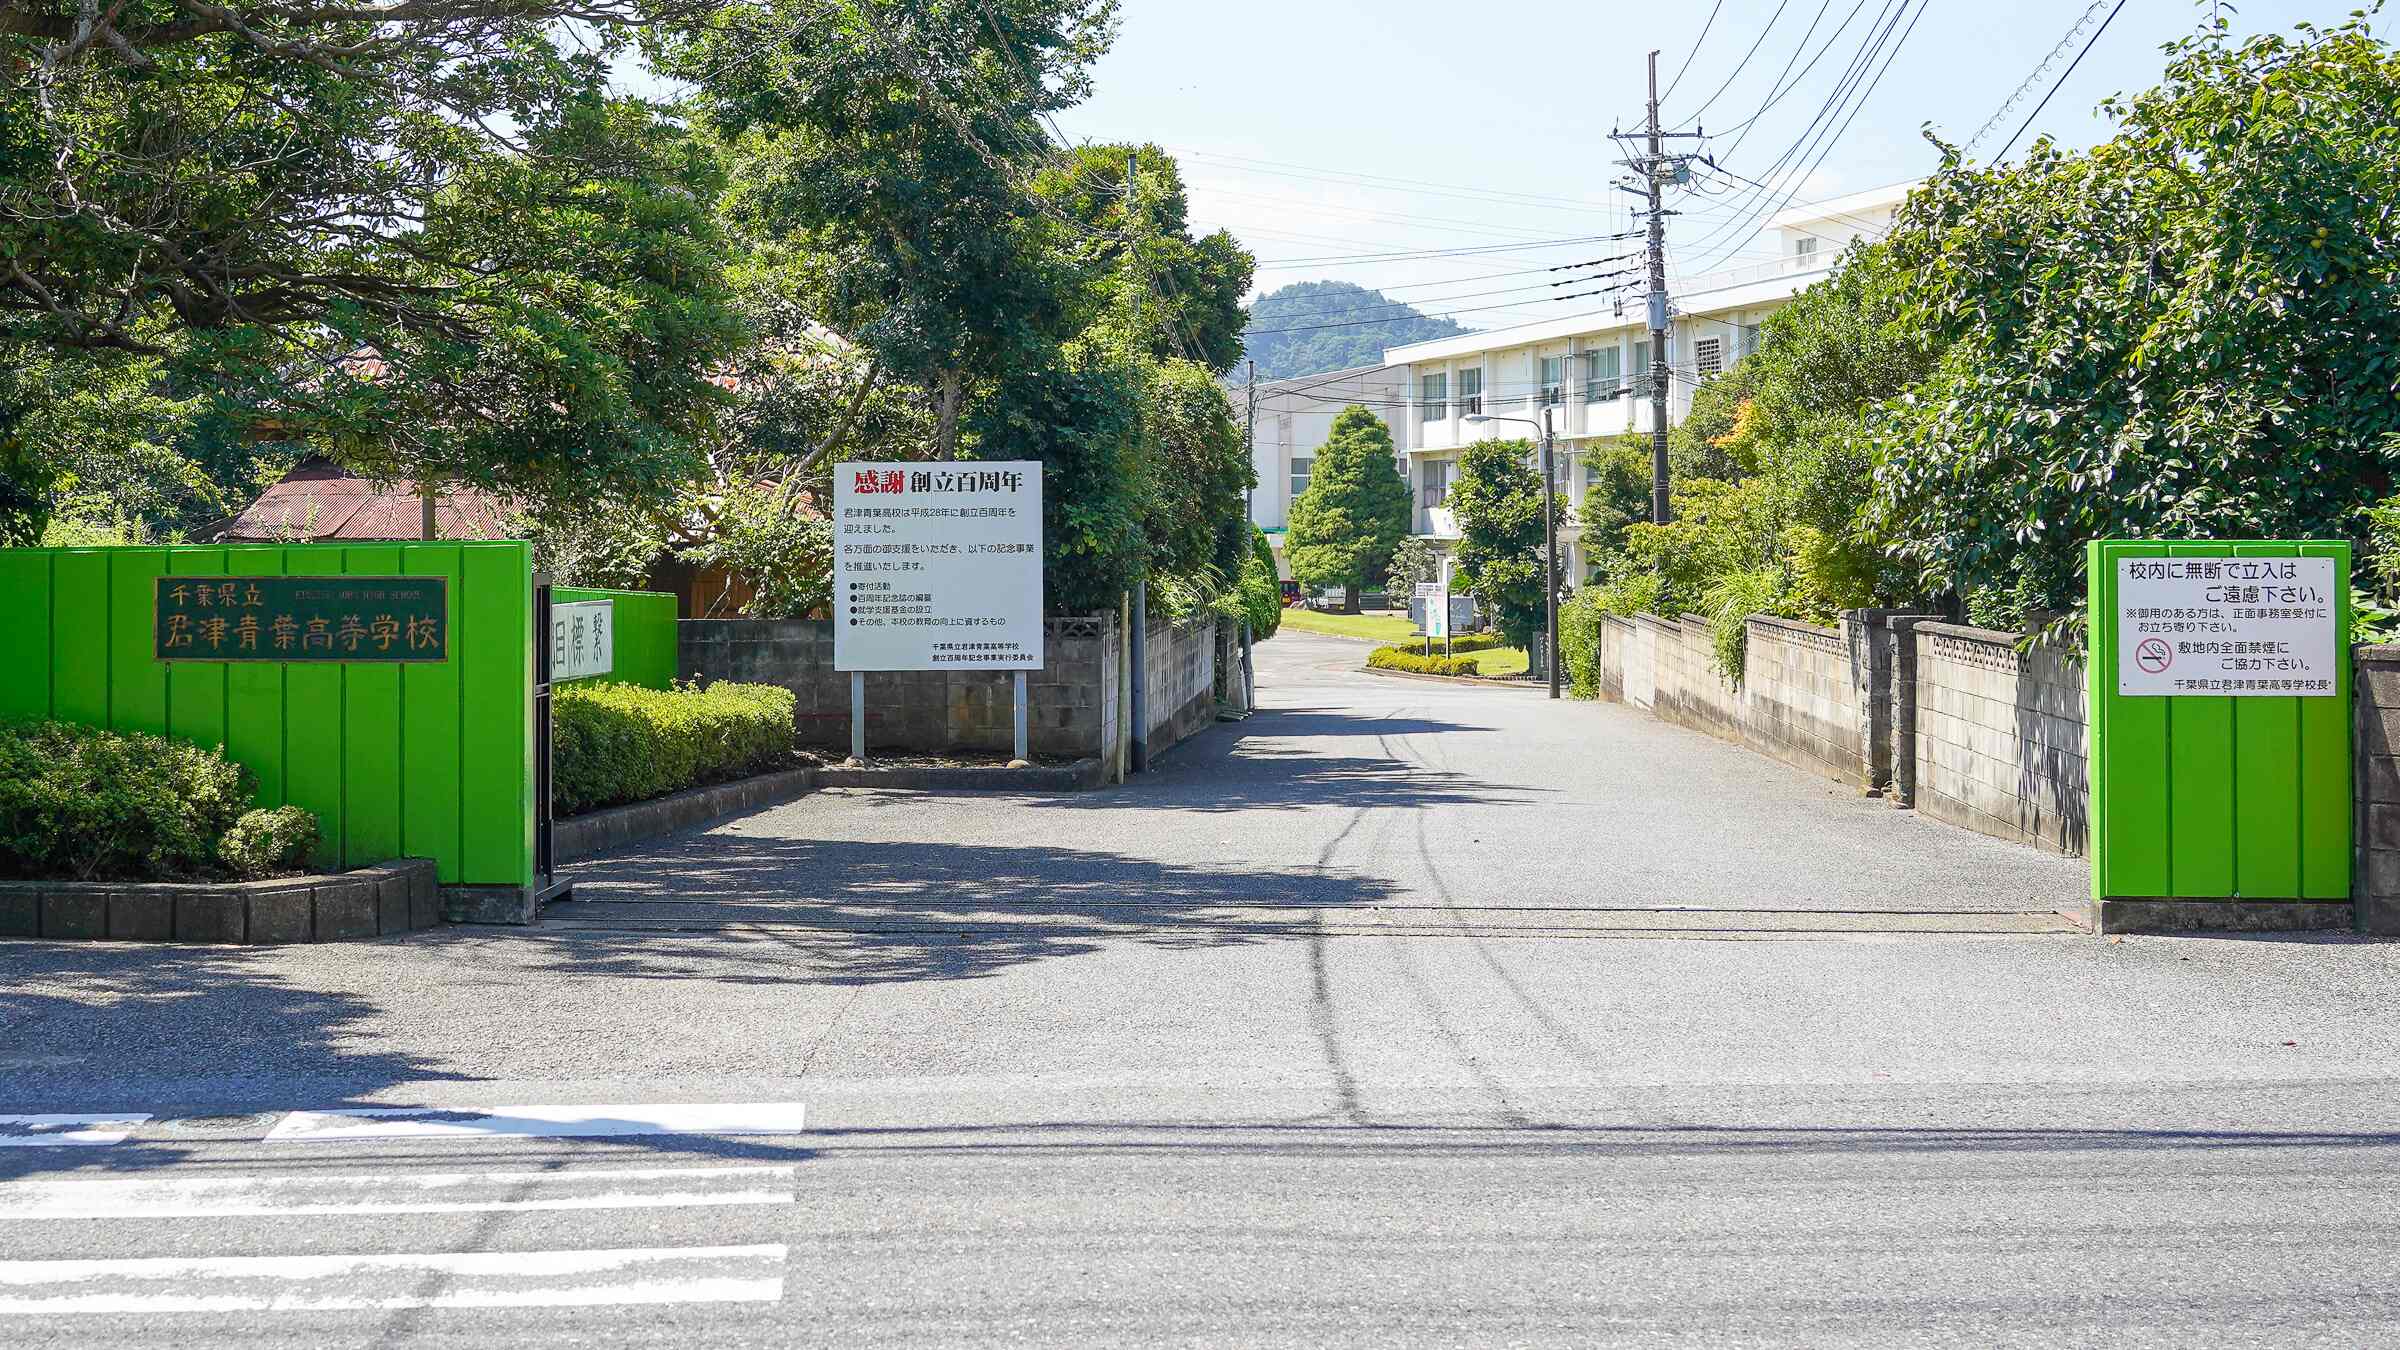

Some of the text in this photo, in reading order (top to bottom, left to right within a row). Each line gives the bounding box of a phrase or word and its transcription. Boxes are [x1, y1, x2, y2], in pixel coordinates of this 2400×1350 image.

[854, 470, 1024, 495] 感謝 創立百周年
[843, 507, 1017, 519] 君津青葉高校は平成28年に創立百周年を
[843, 524, 898, 535] 迎えました。
[843, 543, 1035, 555] 各方面の御支援をいただき、以下の記念事業
[844, 561, 926, 572] を推進いたします。
[2128, 562, 2297, 580] 校内に無断で立入は
[170, 583, 264, 607] 千葉県立
[2205, 585, 2326, 604] ご遠慮下さい。
[164, 613, 441, 651] 君津青葉高等学校
[2138, 621, 2239, 633] お立ち寄り下さい。
[932, 642, 1020, 652] 千葉県立君津青葉高等学校
[2178, 641, 2289, 655] 敷地内全面禁煙に
[932, 653, 1035, 663] 創立百周年記念事業実行委員会
[2220, 658, 2312, 671] ご協力下さい。
[2174, 679, 2328, 691] 千葉県立君津青葉高等学校長
